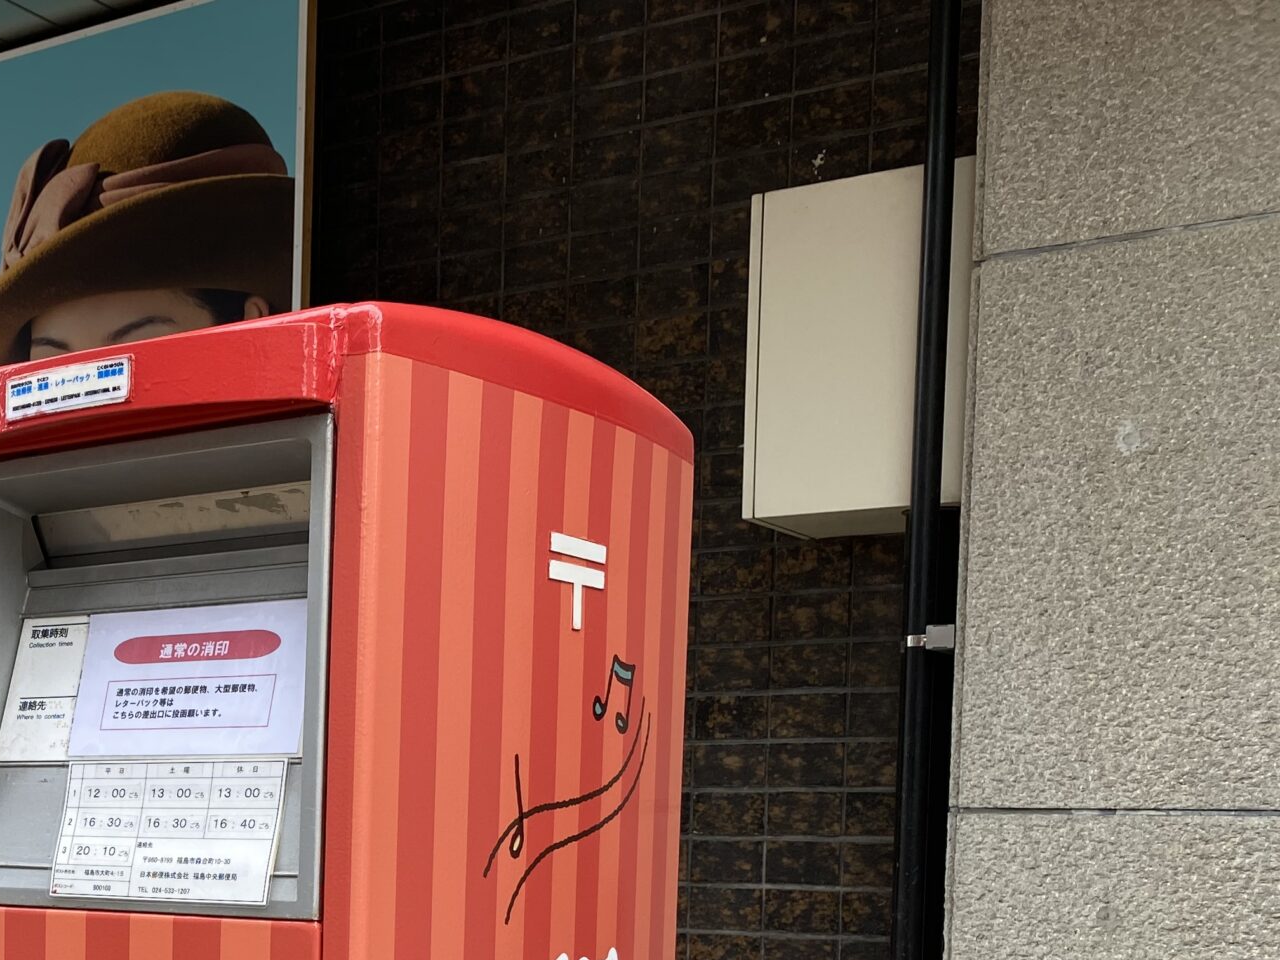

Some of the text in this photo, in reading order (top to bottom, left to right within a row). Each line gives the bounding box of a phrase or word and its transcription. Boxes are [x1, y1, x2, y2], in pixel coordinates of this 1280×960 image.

[30, 627, 69, 640] 取集時刻
[28, 641, 57, 649] Collection
[159, 640, 230, 660] 通常の消印
[18, 700, 47, 711] 連絡先
[114, 697, 174, 708] レターパック等は
[16, 713, 34, 721] Where
[112, 707, 223, 720] こちらの差出口に投函願います。
[169, 766, 191, 775] 土曜
[236, 765, 260, 774] 休日
